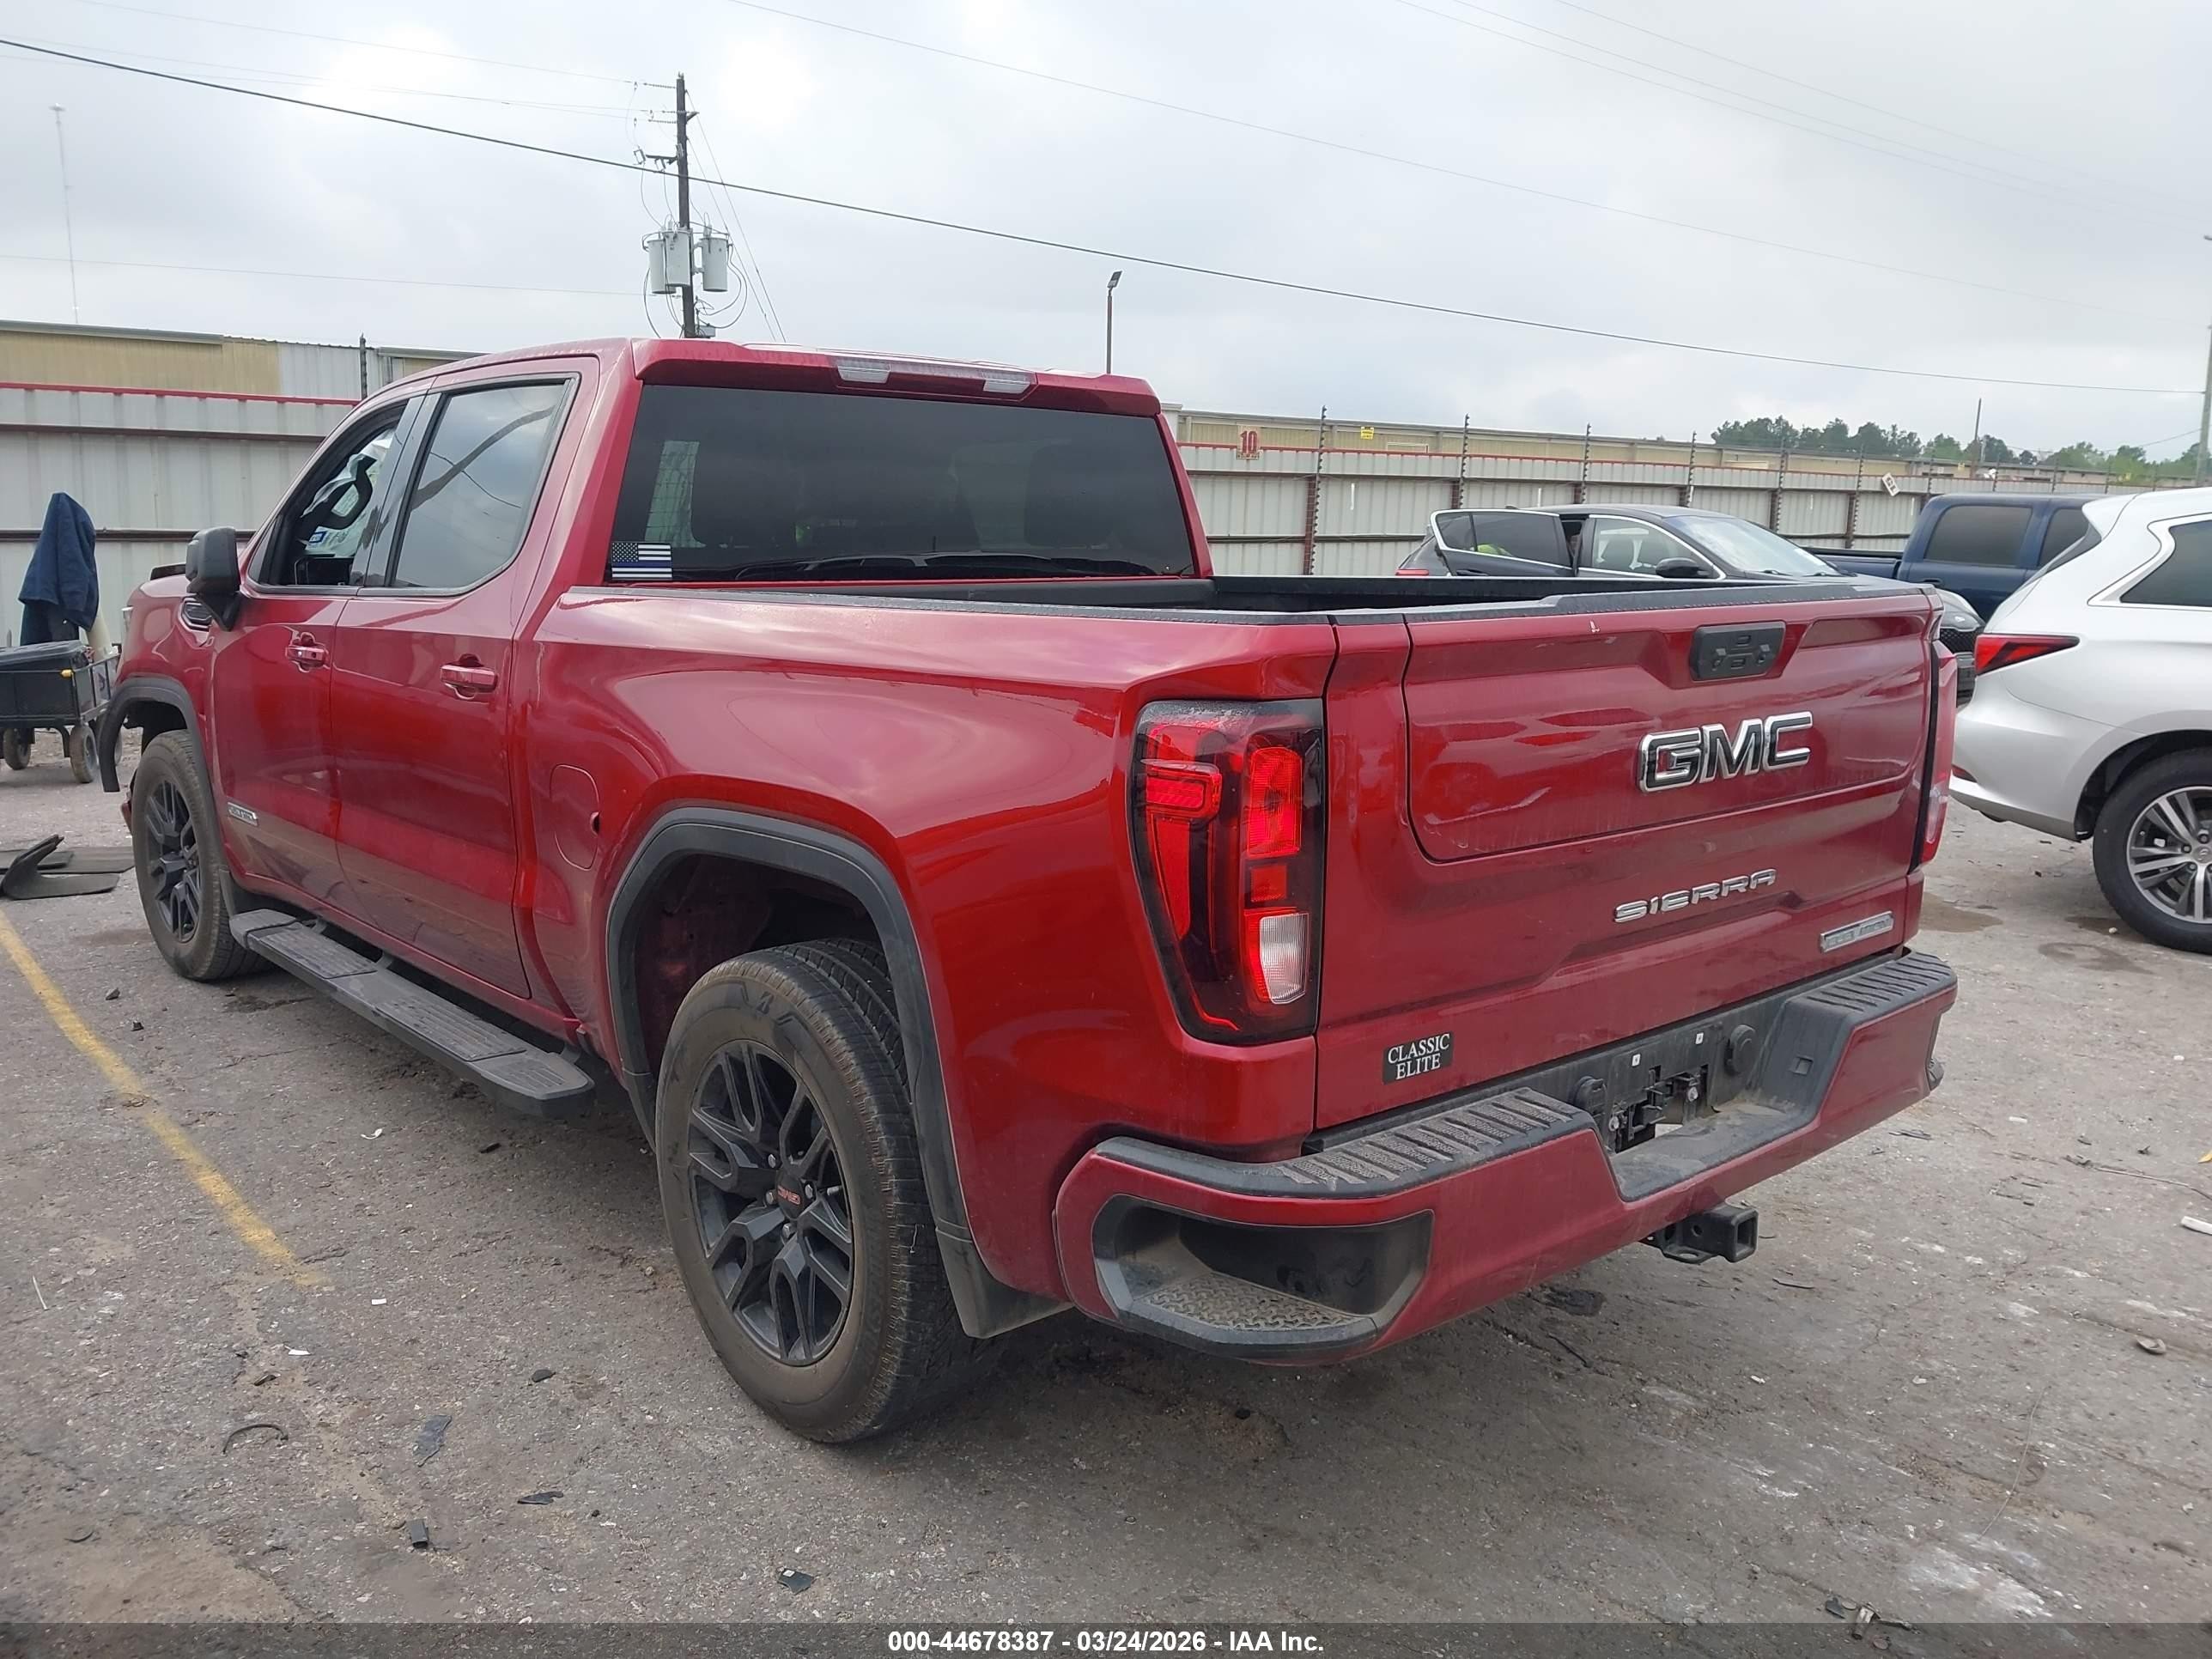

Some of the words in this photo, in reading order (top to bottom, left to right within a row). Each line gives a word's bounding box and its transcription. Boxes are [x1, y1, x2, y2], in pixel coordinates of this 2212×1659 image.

[1240, 430, 1257, 454] 10
[1639, 711, 1813, 793] GMC
[1613, 868, 1777, 923] SIERRA
[1388, 1033, 1450, 1064] CLASSIC
[1395, 1053, 1441, 1080] ELITE
